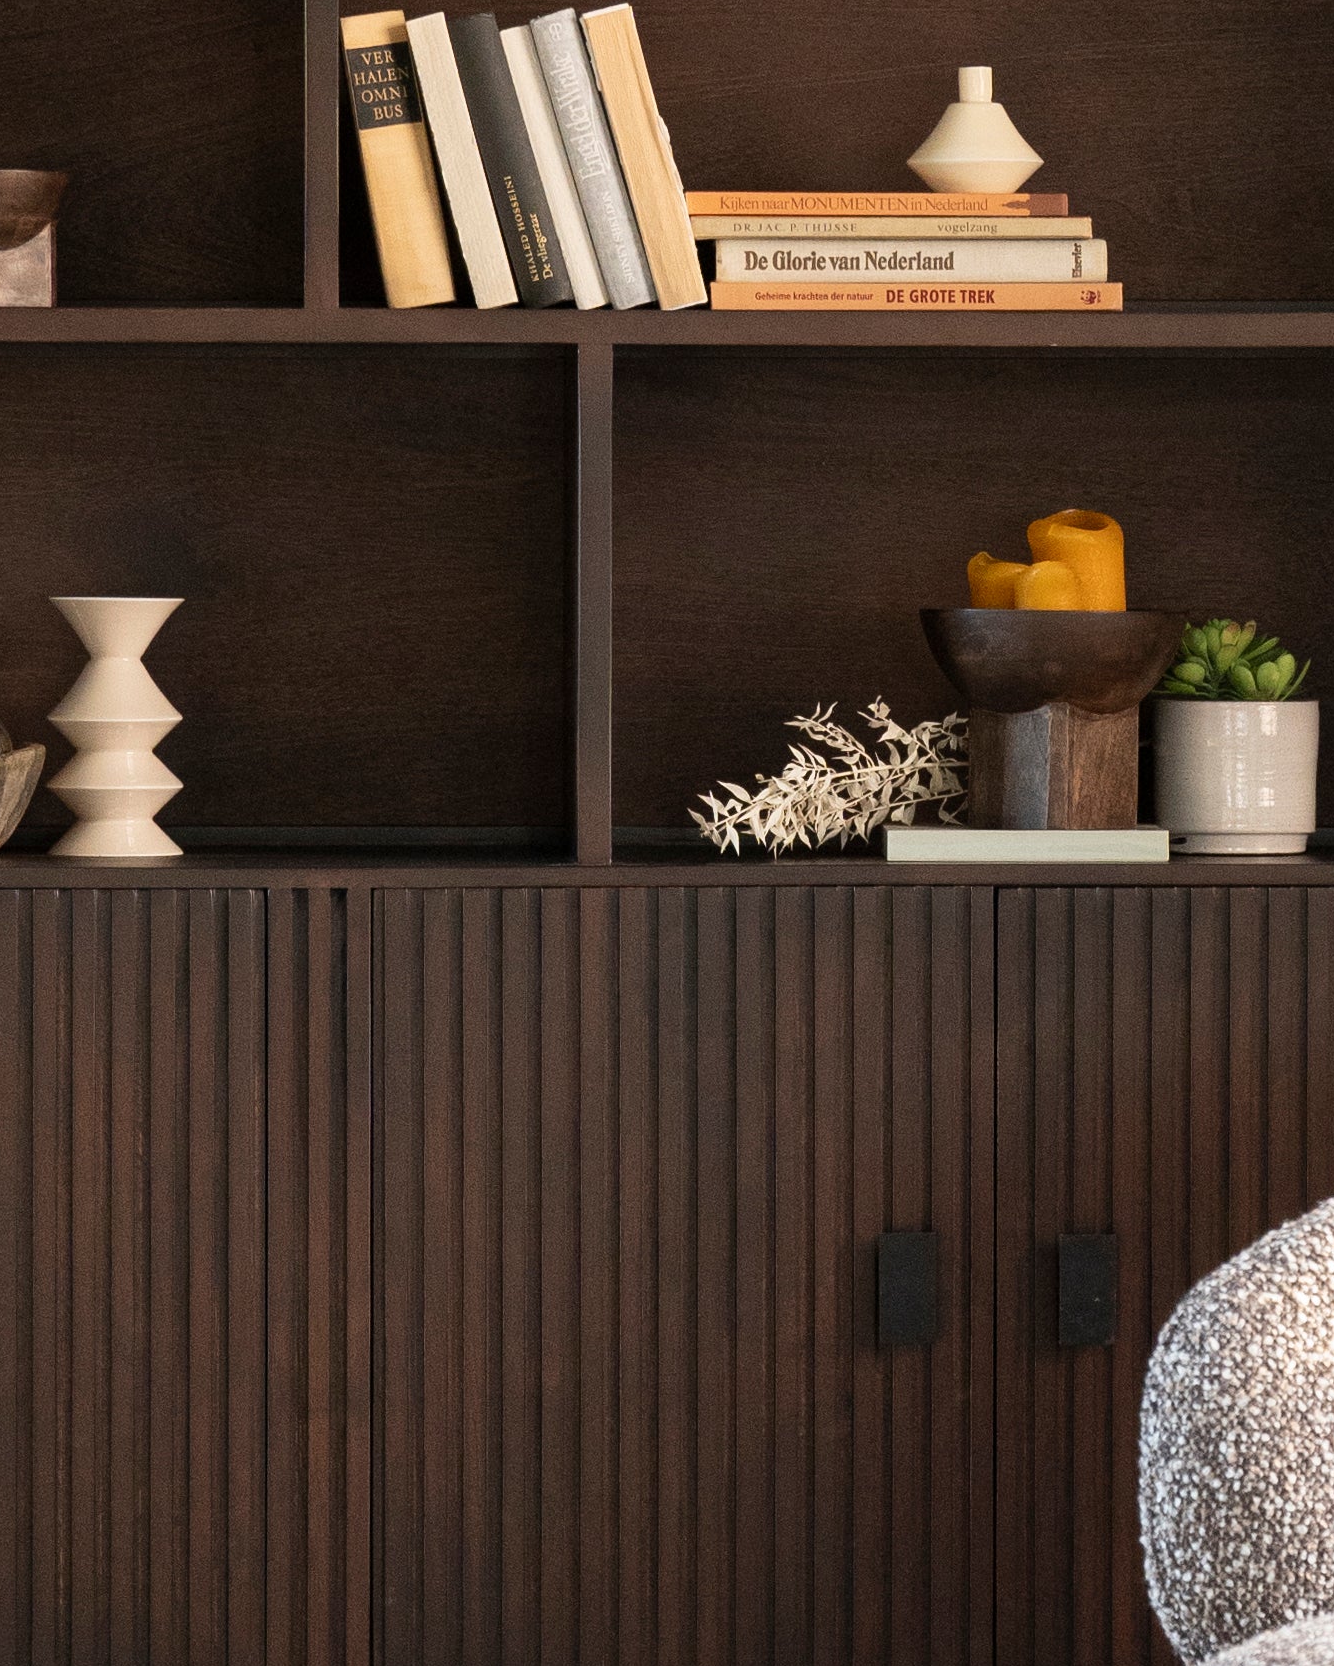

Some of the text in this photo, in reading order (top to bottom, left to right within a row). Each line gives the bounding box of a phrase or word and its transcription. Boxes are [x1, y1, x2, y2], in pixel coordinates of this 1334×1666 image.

[360, 50, 395, 66] VER
[354, 67, 410, 86] HALEN
[361, 85, 409, 104] OMNI
[373, 104, 404, 121] BUS
[571, 134, 607, 180] Engel
[720, 196, 989, 212] Kijken naar MONUMENTEN in Nederland
[602, 191, 623, 243] SHELDON
[503, 175, 540, 282] KHALED HOSSEINI
[733, 223, 754, 232] DR.
[937, 221, 998, 234] vogelzang
[529, 213, 554, 280] De vliegeraar
[744, 250, 955, 271] De Glorie van Nederland
[1071, 242, 1083, 279] Elsevier
[755, 291, 874, 302] Geheime krachten der natuur
[886, 289, 996, 304] DE GROTE TREK
